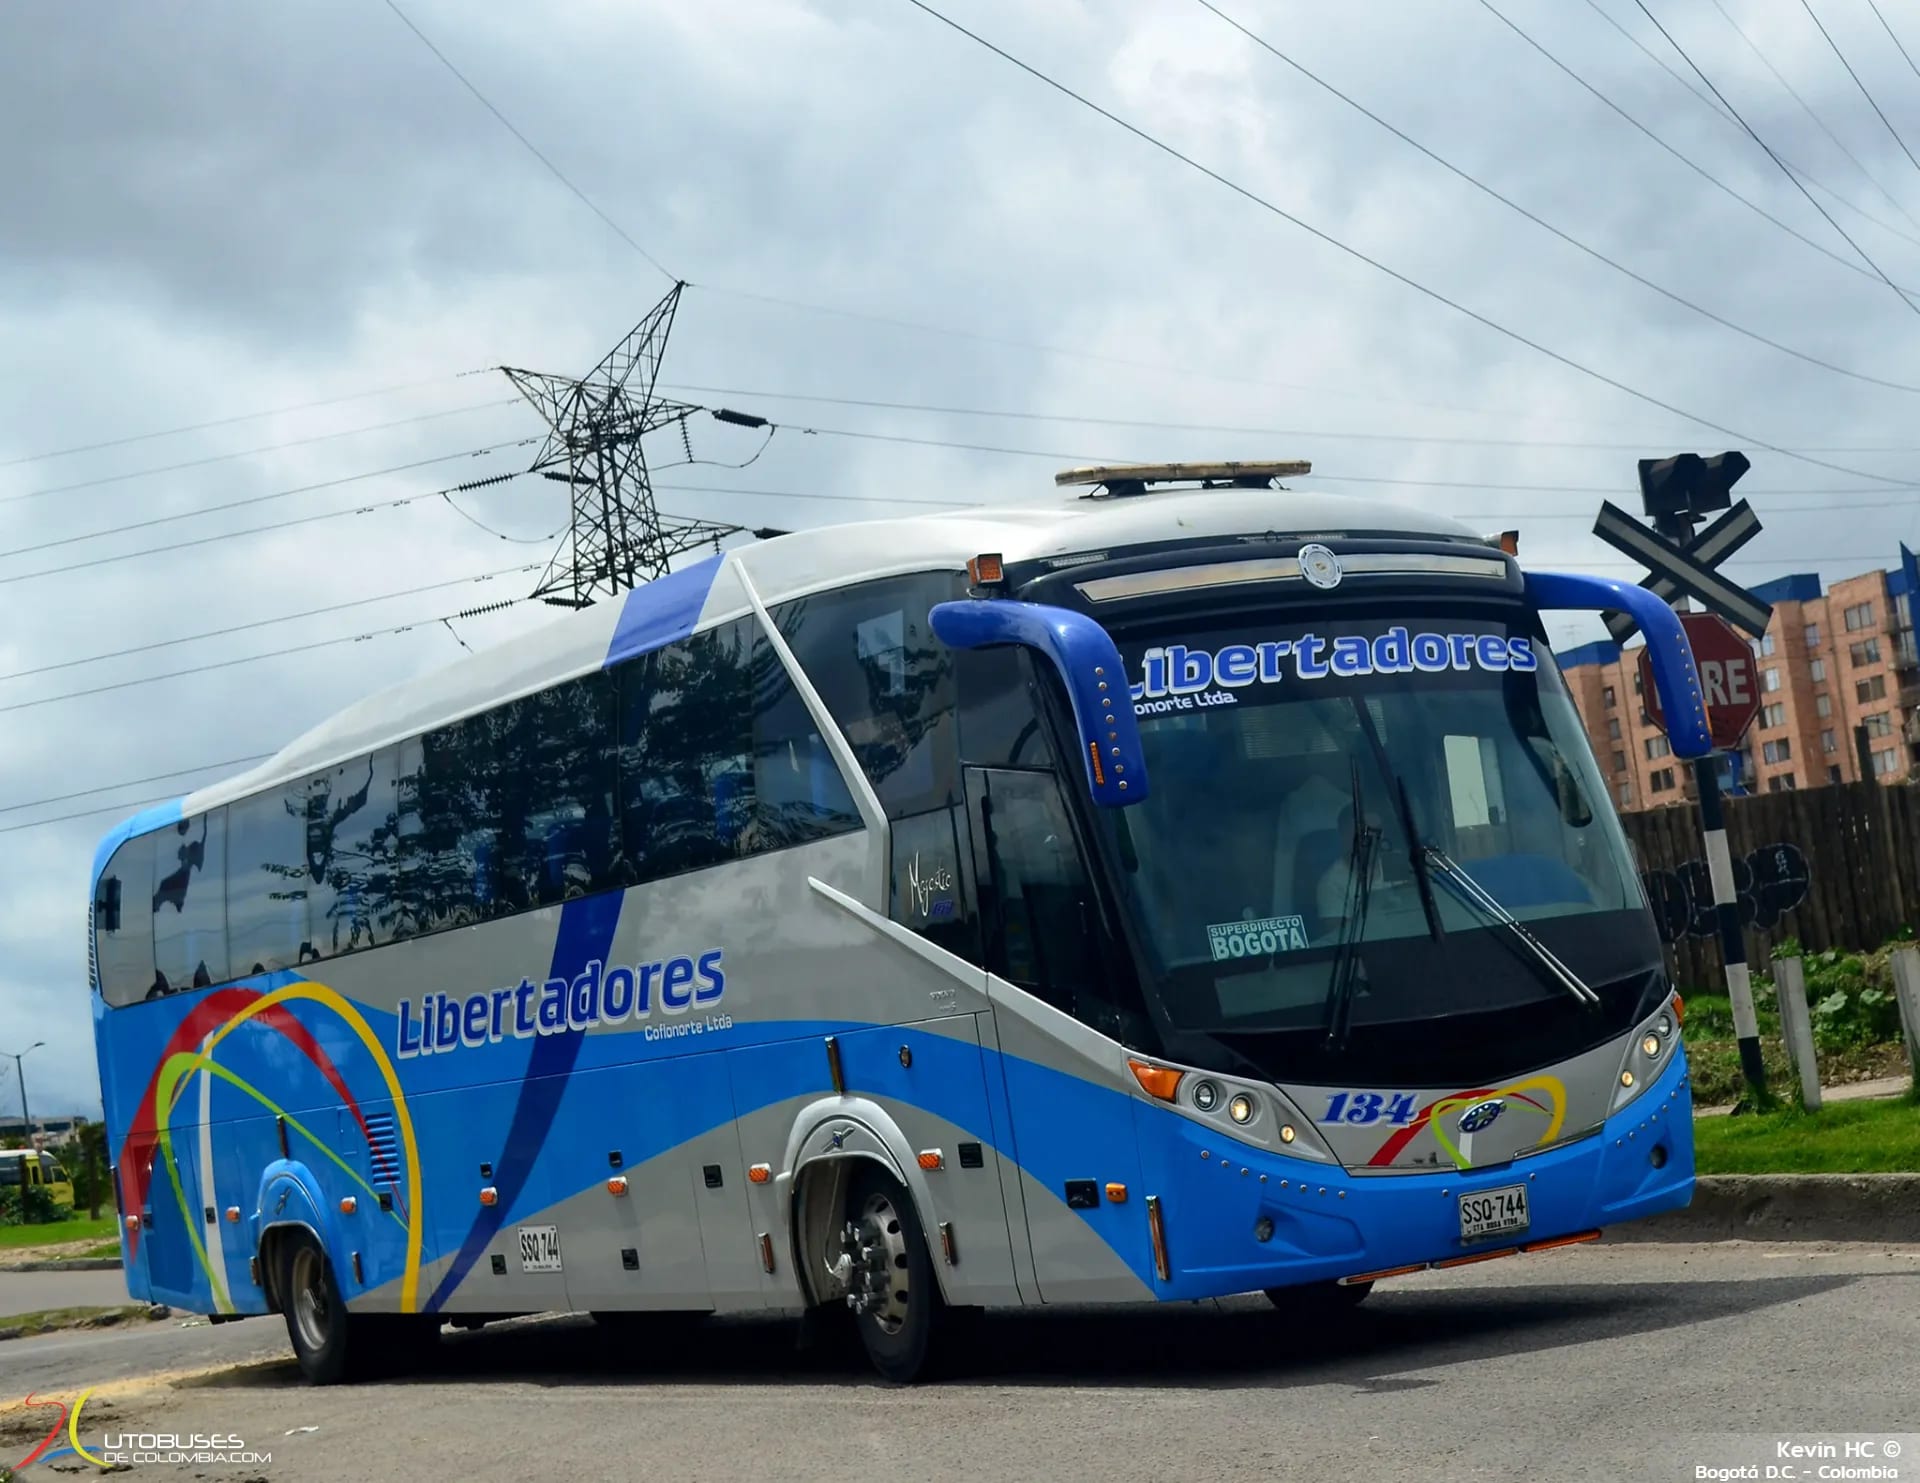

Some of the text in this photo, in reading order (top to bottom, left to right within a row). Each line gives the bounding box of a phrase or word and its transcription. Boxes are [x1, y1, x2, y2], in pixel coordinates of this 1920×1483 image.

[1134, 690, 1238, 716] onorte Ltda.
[1210, 917, 1300, 937] SUPERDIRECTO
[1212, 927, 1306, 960] BOGOTA
[397, 947, 726, 1060] Libertadores
[705, 1013, 733, 1032] Ltda
[1317, 1090, 1420, 1128] 134
